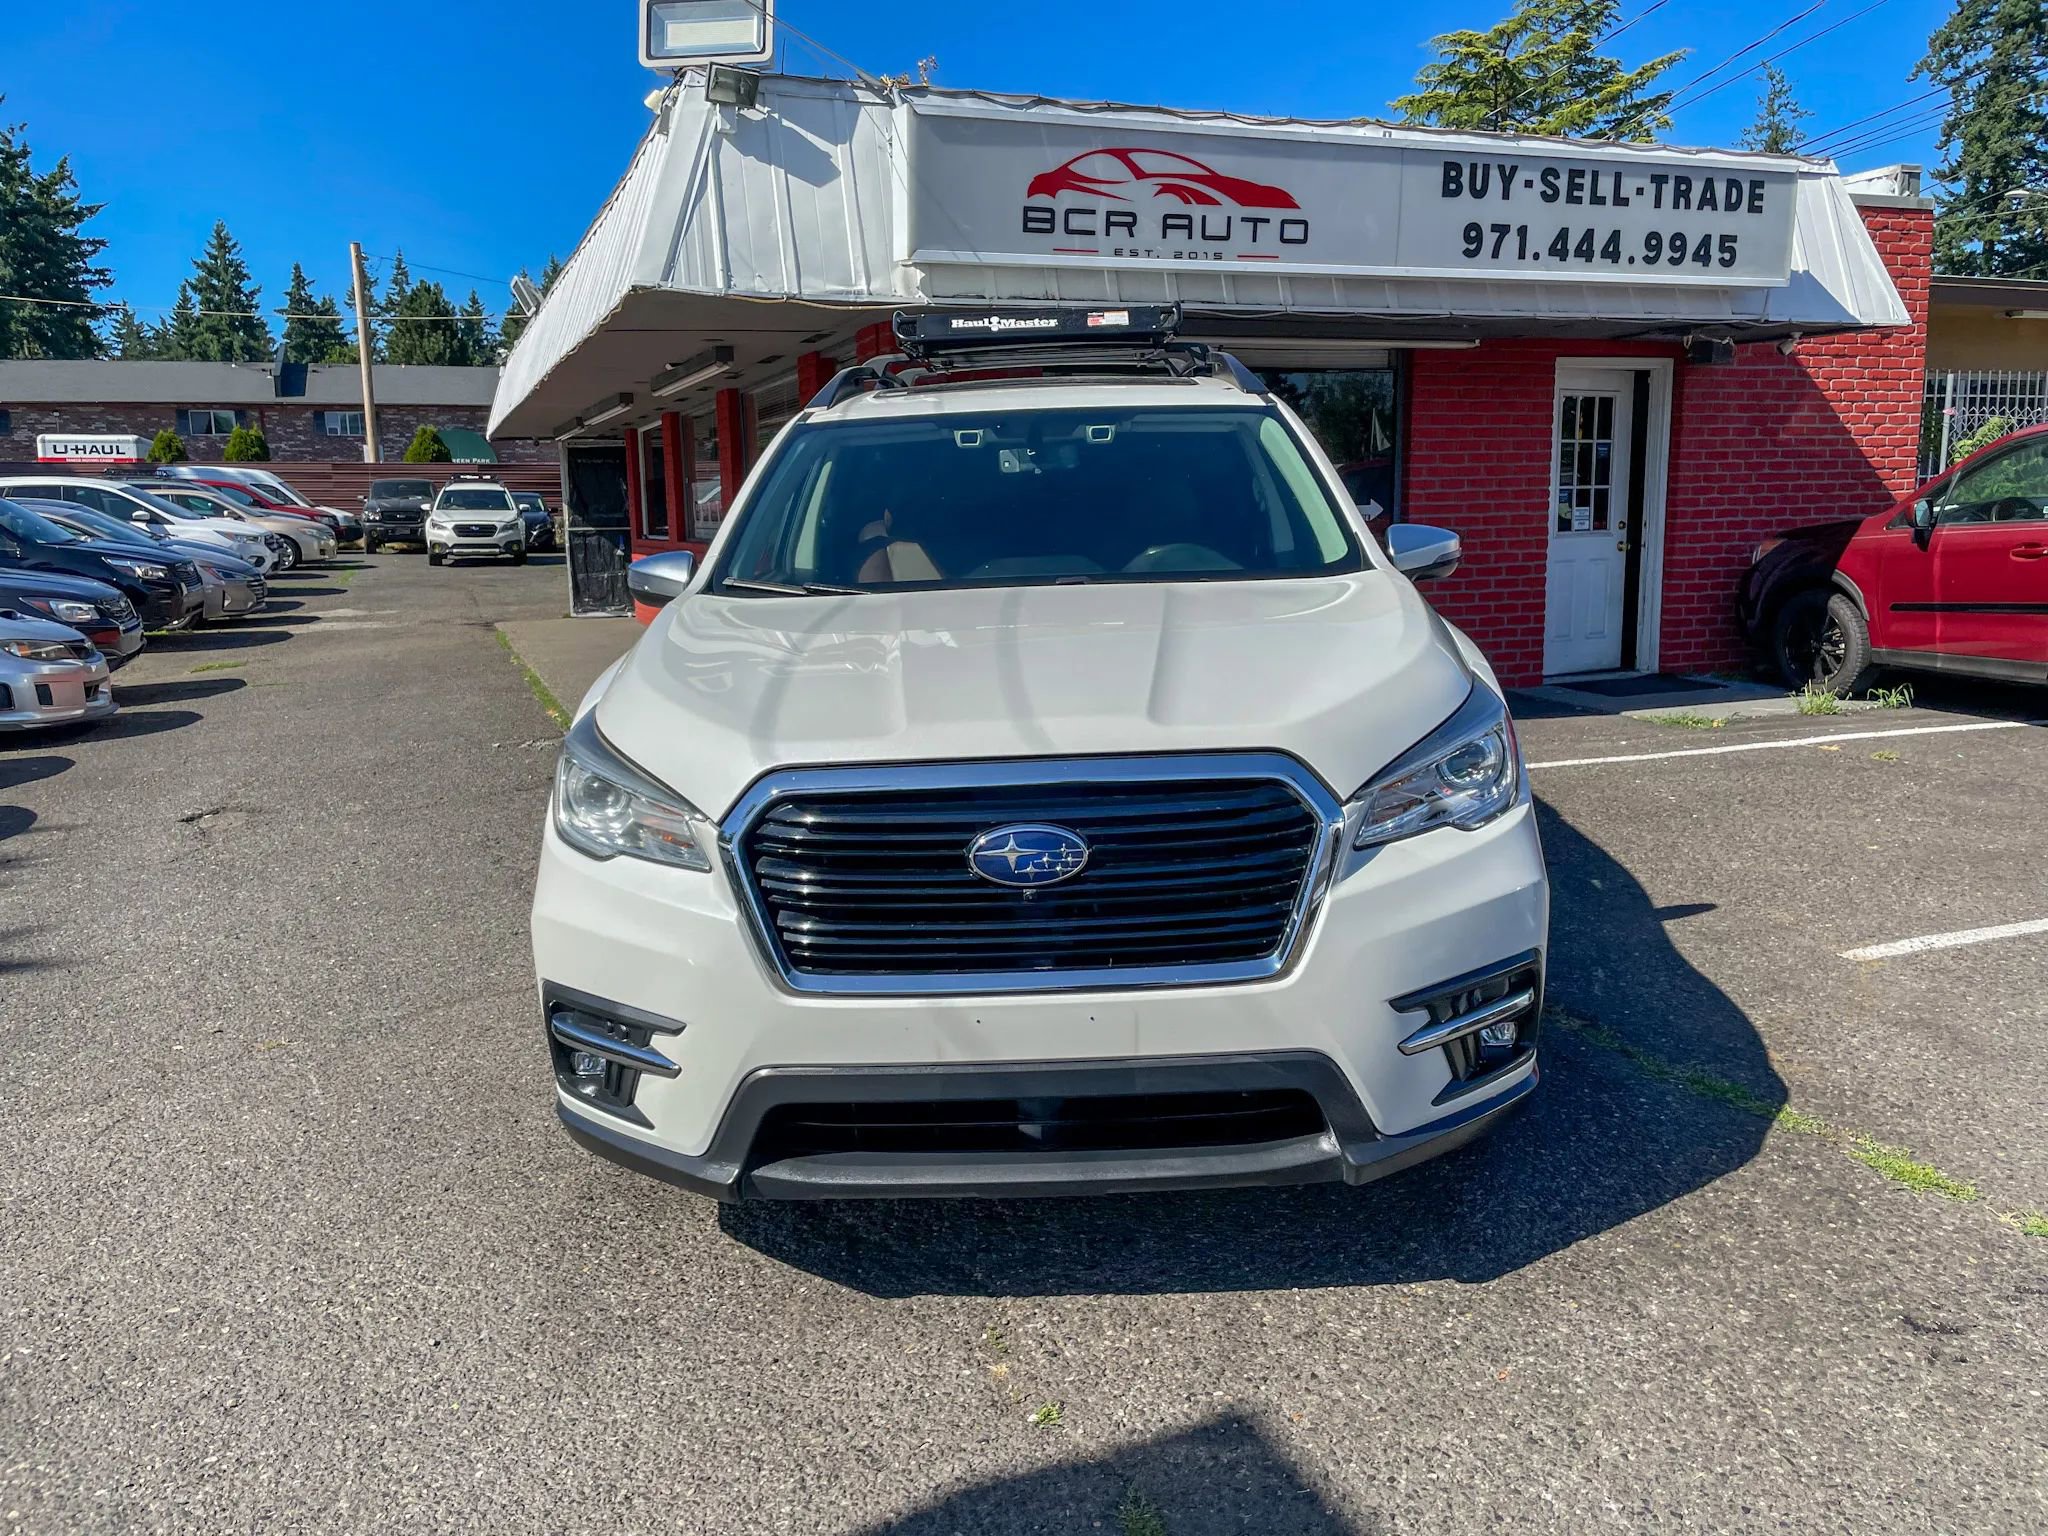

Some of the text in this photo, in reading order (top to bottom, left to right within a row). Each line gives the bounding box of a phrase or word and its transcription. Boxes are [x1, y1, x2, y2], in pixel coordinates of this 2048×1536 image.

[1022, 205, 1309, 245] BCR AUTO
[1461, 222, 1739, 269] 971.444.9945
[1114, 248, 1223, 261] EST. 2015
[951, 317, 1058, 329] Haul Master
[53, 444, 126, 455] U-HAUL
